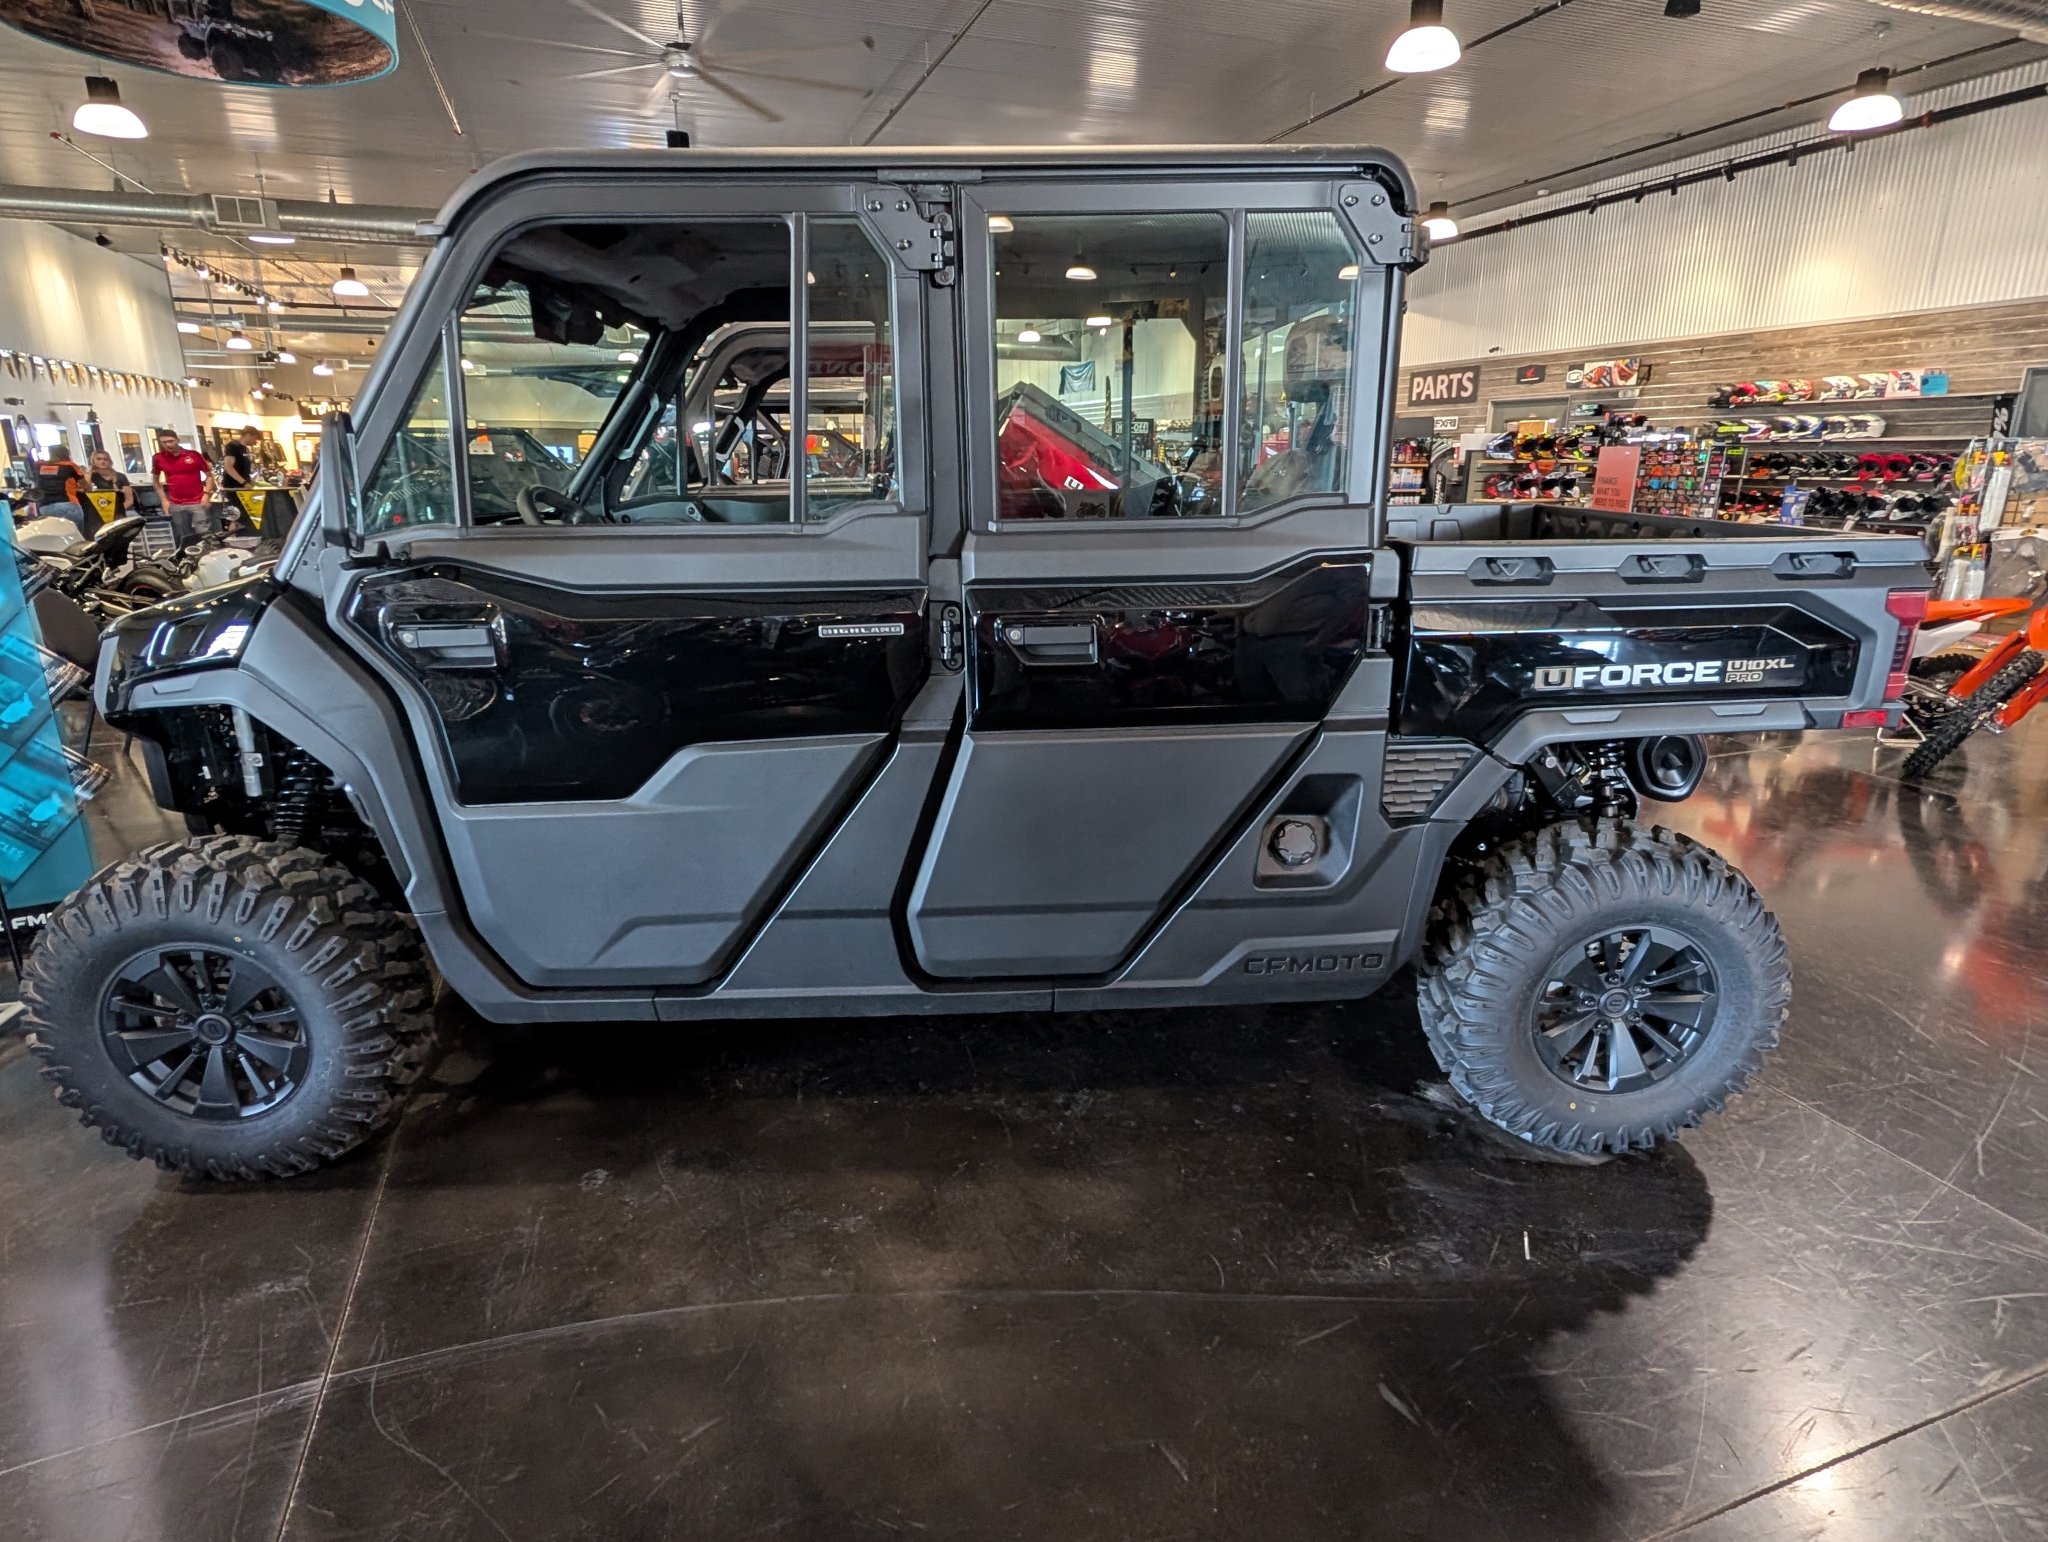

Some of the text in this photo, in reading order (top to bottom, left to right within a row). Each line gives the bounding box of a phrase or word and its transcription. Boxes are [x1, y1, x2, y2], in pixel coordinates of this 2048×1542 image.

[1411, 371, 1474, 401] PARTS
[1726, 658, 1796, 673] U10XL
[1725, 671, 1765, 683] PRO
[1243, 952, 1384, 976] CFMOTO
